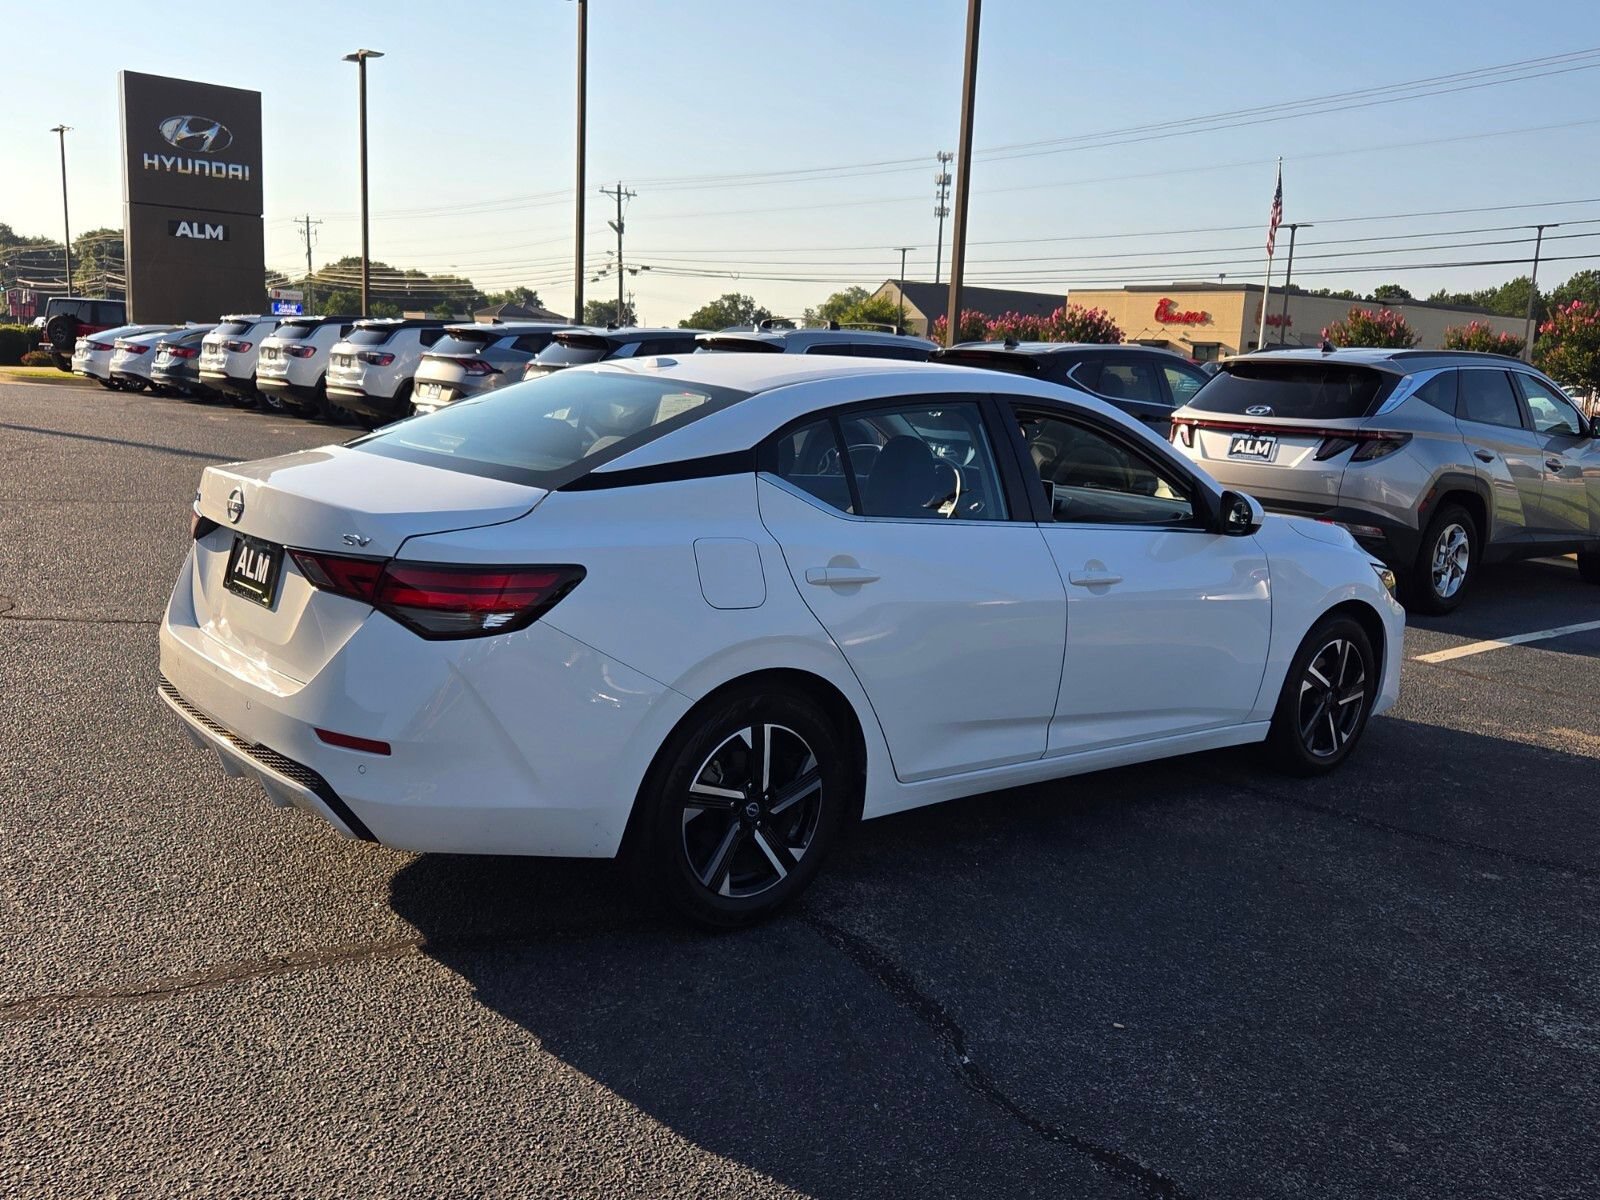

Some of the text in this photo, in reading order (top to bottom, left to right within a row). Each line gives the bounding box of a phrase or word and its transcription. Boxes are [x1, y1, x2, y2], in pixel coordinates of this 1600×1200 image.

[143, 152, 250, 181] HYUNDAI
[175, 221, 224, 241] ALM
[1232, 439, 1271, 456] ALM
[343, 533, 372, 547] SV
[234, 545, 271, 585] ALM
